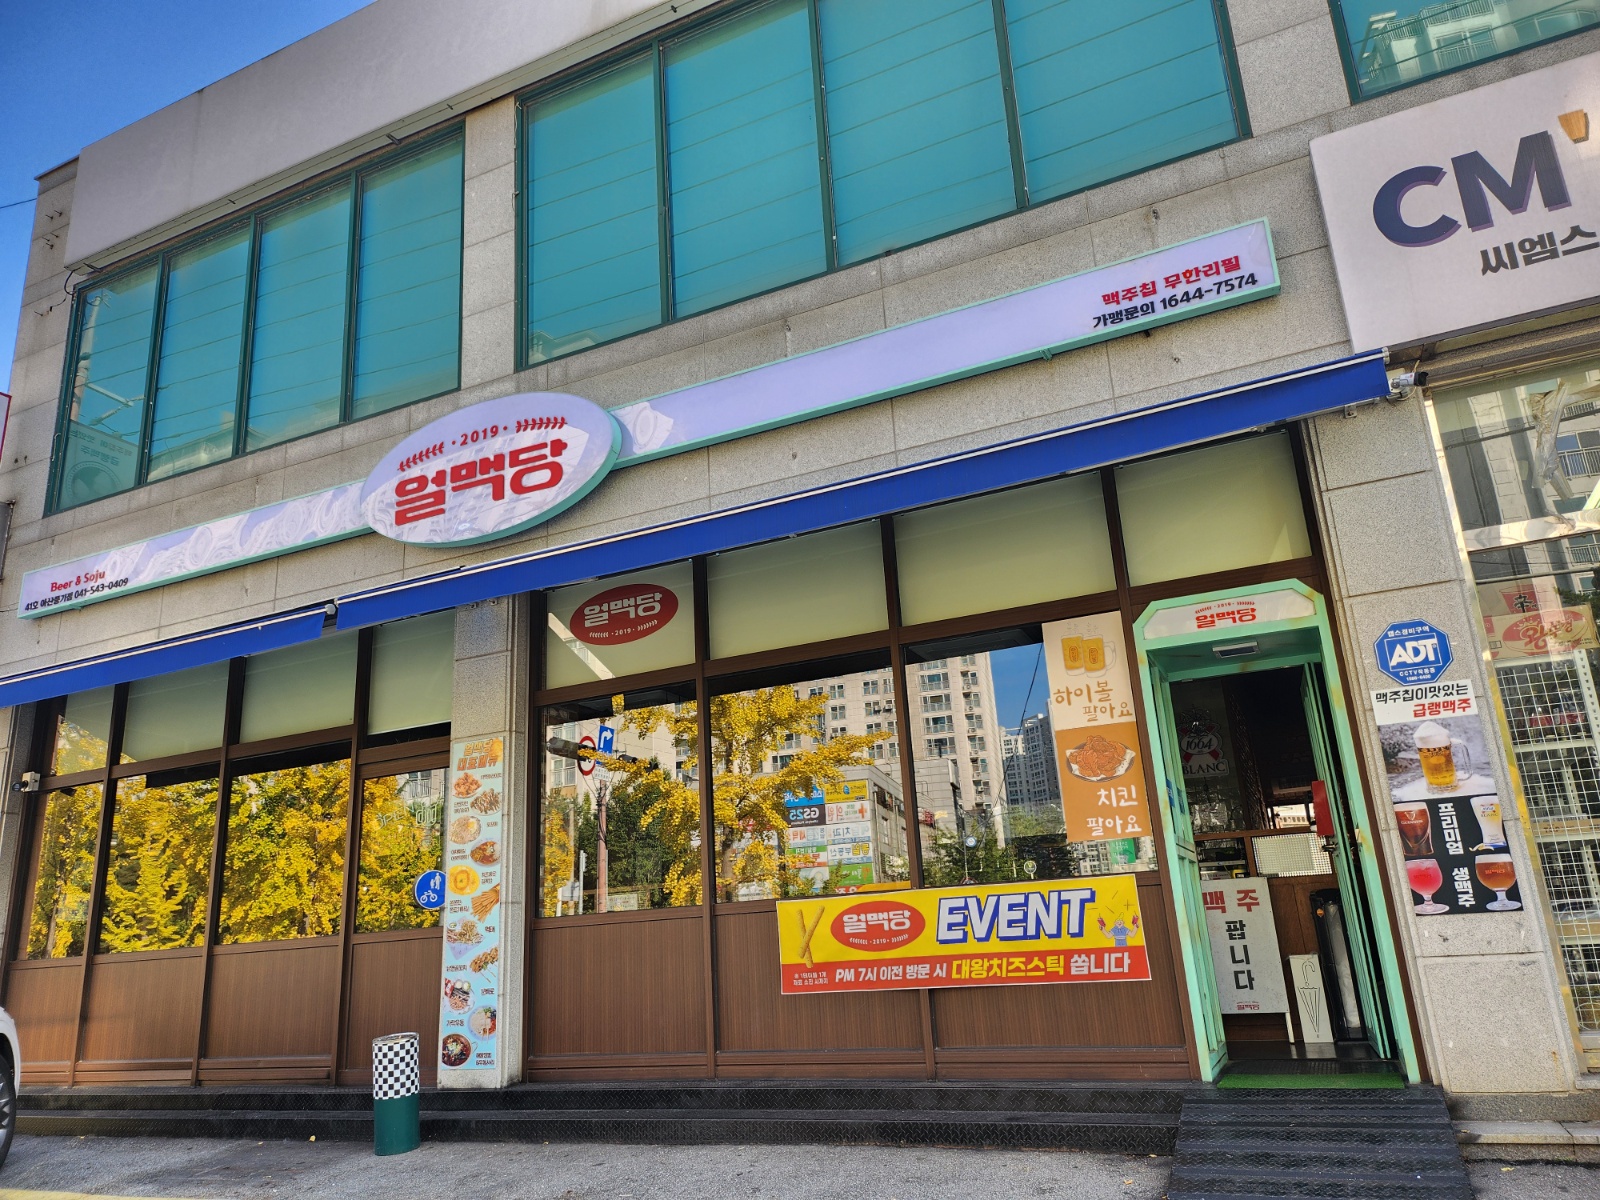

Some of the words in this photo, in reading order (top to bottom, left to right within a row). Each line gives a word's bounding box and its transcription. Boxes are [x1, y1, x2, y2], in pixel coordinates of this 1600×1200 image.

[1373, 130, 1572, 248] CM
[1480, 224, 1600, 276] 씨엠스
[1101, 280, 1157, 306] 맥주칩
[1163, 255, 1241, 289] 무한리필
[1093, 301, 1155, 328] 가맹문의
[1159, 272, 1258, 310] 1644-7574
[459, 424, 499, 446] 2019
[394, 438, 568, 526] 얼맥당
[50, 580, 74, 592] Beer
[75, 576, 82, 586] &
[84, 569, 106, 584] Soju
[74, 577, 129, 599] 041-543-0409
[584, 592, 662, 627] 얼맥당
[1195, 607, 1256, 629] 얼맥당
[615, 628, 632, 636] 2019
[1390, 638, 1438, 666] ADT
[1053, 681, 1113, 706] 하이볼
[1083, 701, 1133, 722] 팔아요
[1413, 698, 1471, 718] 급랭맥주
[1185, 737, 1214, 750] 1664
[1183, 762, 1226, 775] BLANC
[1097, 784, 1138, 807] 치킨
[1086, 814, 1142, 837] 팔아요
[1438, 802, 1465, 855] 프리미엄
[1451, 866, 1476, 908] 생맥주
[842, 909, 911, 934] 얼맥당
[936, 888, 1096, 945] EVENT
[835, 968, 856, 983] PM
[858, 966, 877, 982] 7시
[880, 965, 903, 981] 이전
[906, 963, 931, 979] 방문
[933, 963, 947, 978] 시
[951, 954, 1065, 980] 대왕치즈스틱
[1070, 952, 1131, 975] 쏩니다
[1225, 919, 1255, 991] 팝니다
